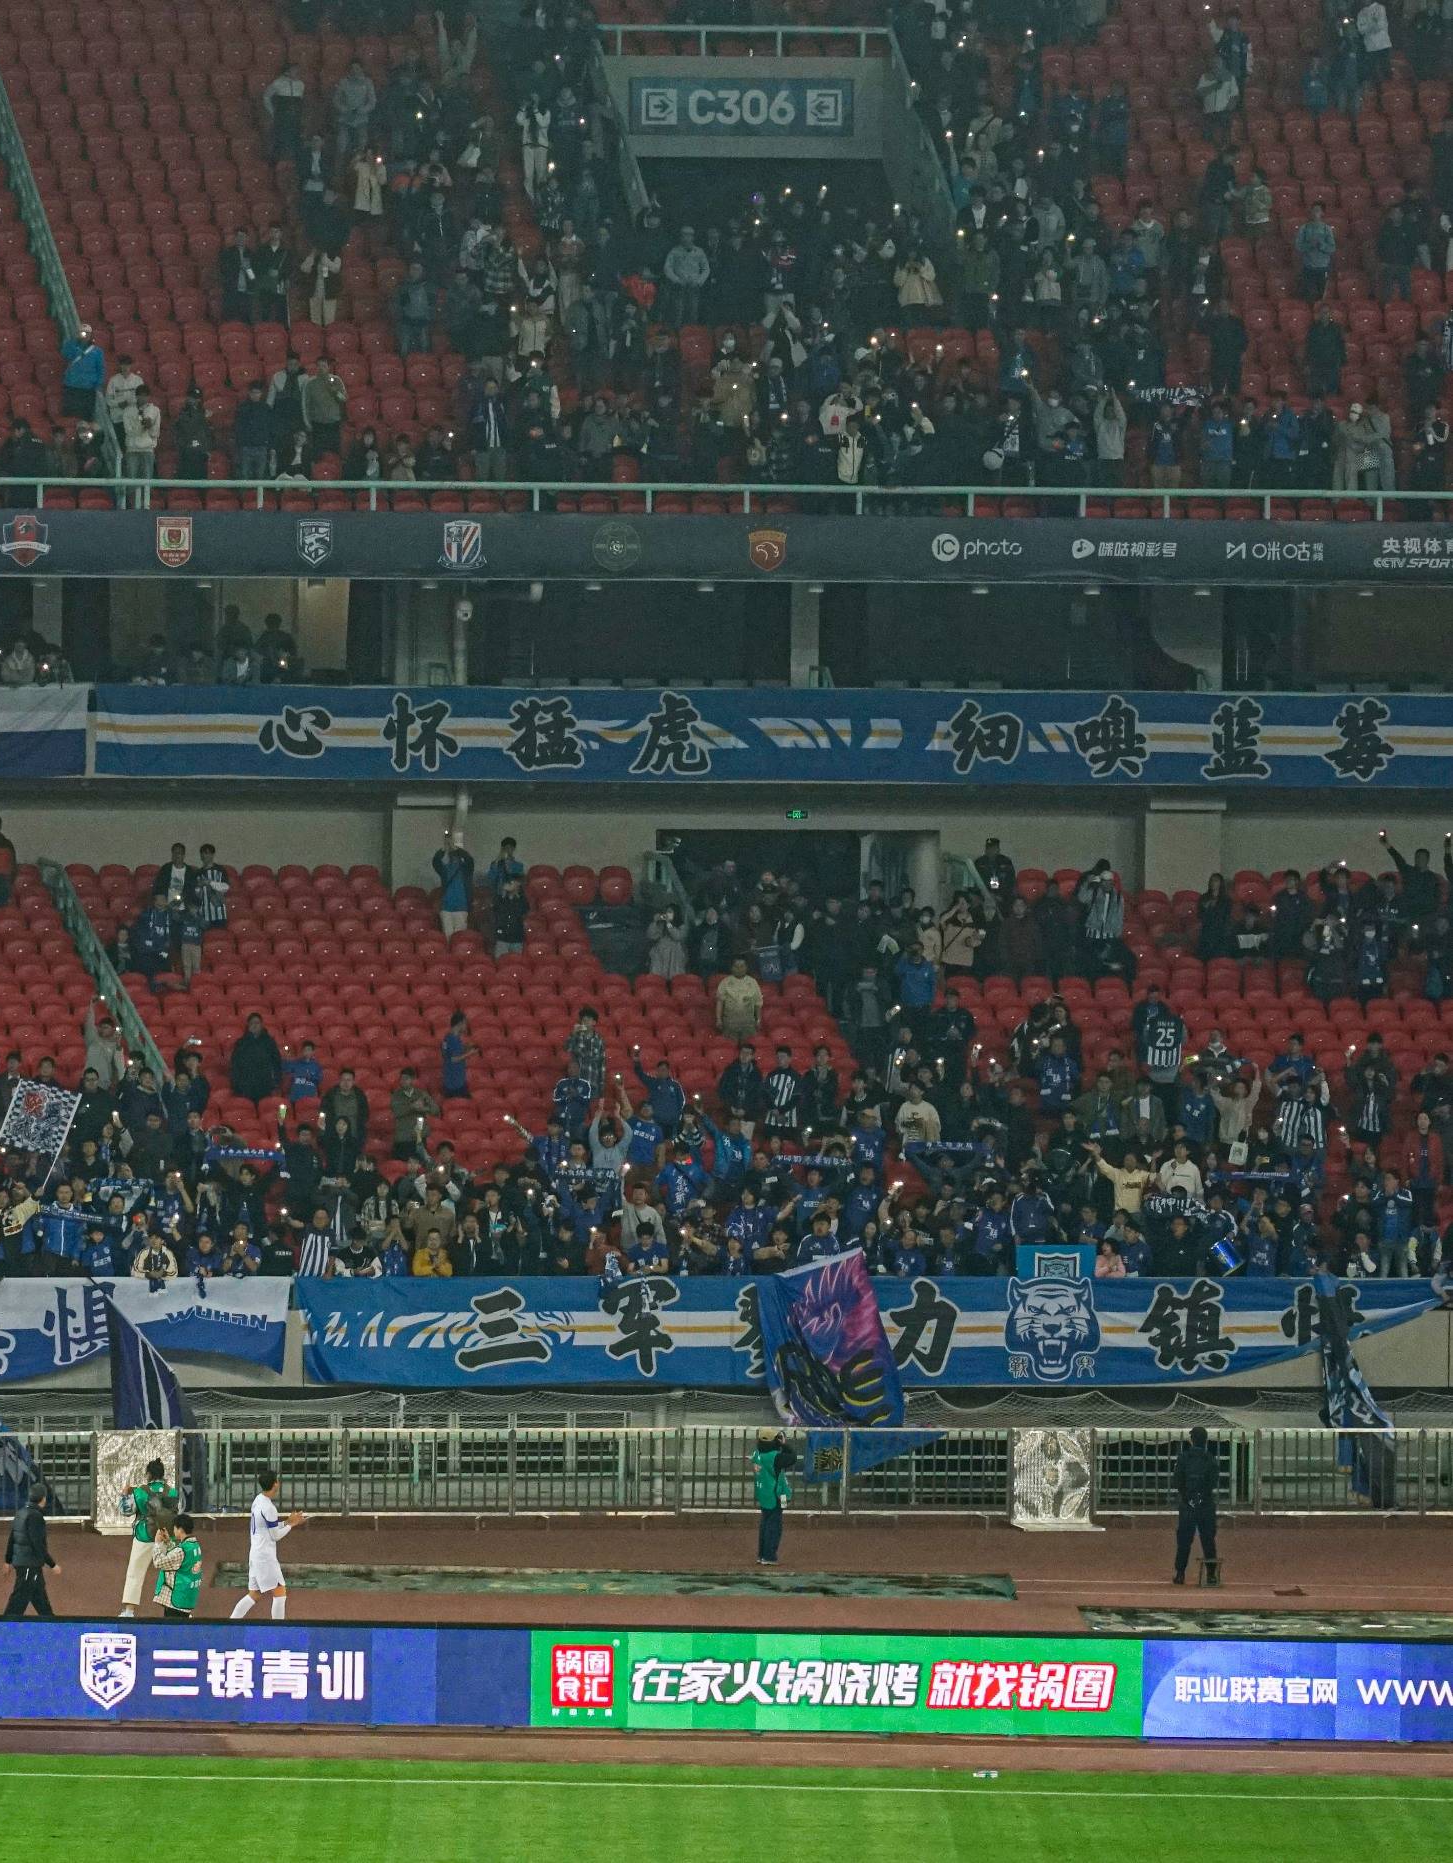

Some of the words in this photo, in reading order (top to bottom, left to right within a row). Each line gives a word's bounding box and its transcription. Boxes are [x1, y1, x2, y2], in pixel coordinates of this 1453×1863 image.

[688, 89, 796, 126] C306
[963, 538, 1023, 560] photo
[1407, 557, 1453, 568] SPOR
[258, 691, 712, 775] 心怀猛虎
[1156, 1028, 1175, 1047] 25
[165, 1304, 269, 1332] WUHAN
[151, 1649, 365, 1700] 三镇青训
[556, 1650, 610, 1675] 锅圈
[556, 1676, 610, 1702] 食汇
[629, 1657, 920, 1707] 在家火锅烧烤
[927, 1661, 1117, 1709] 就找锅圈
[1174, 1675, 1338, 1705] 职业联赛官网
